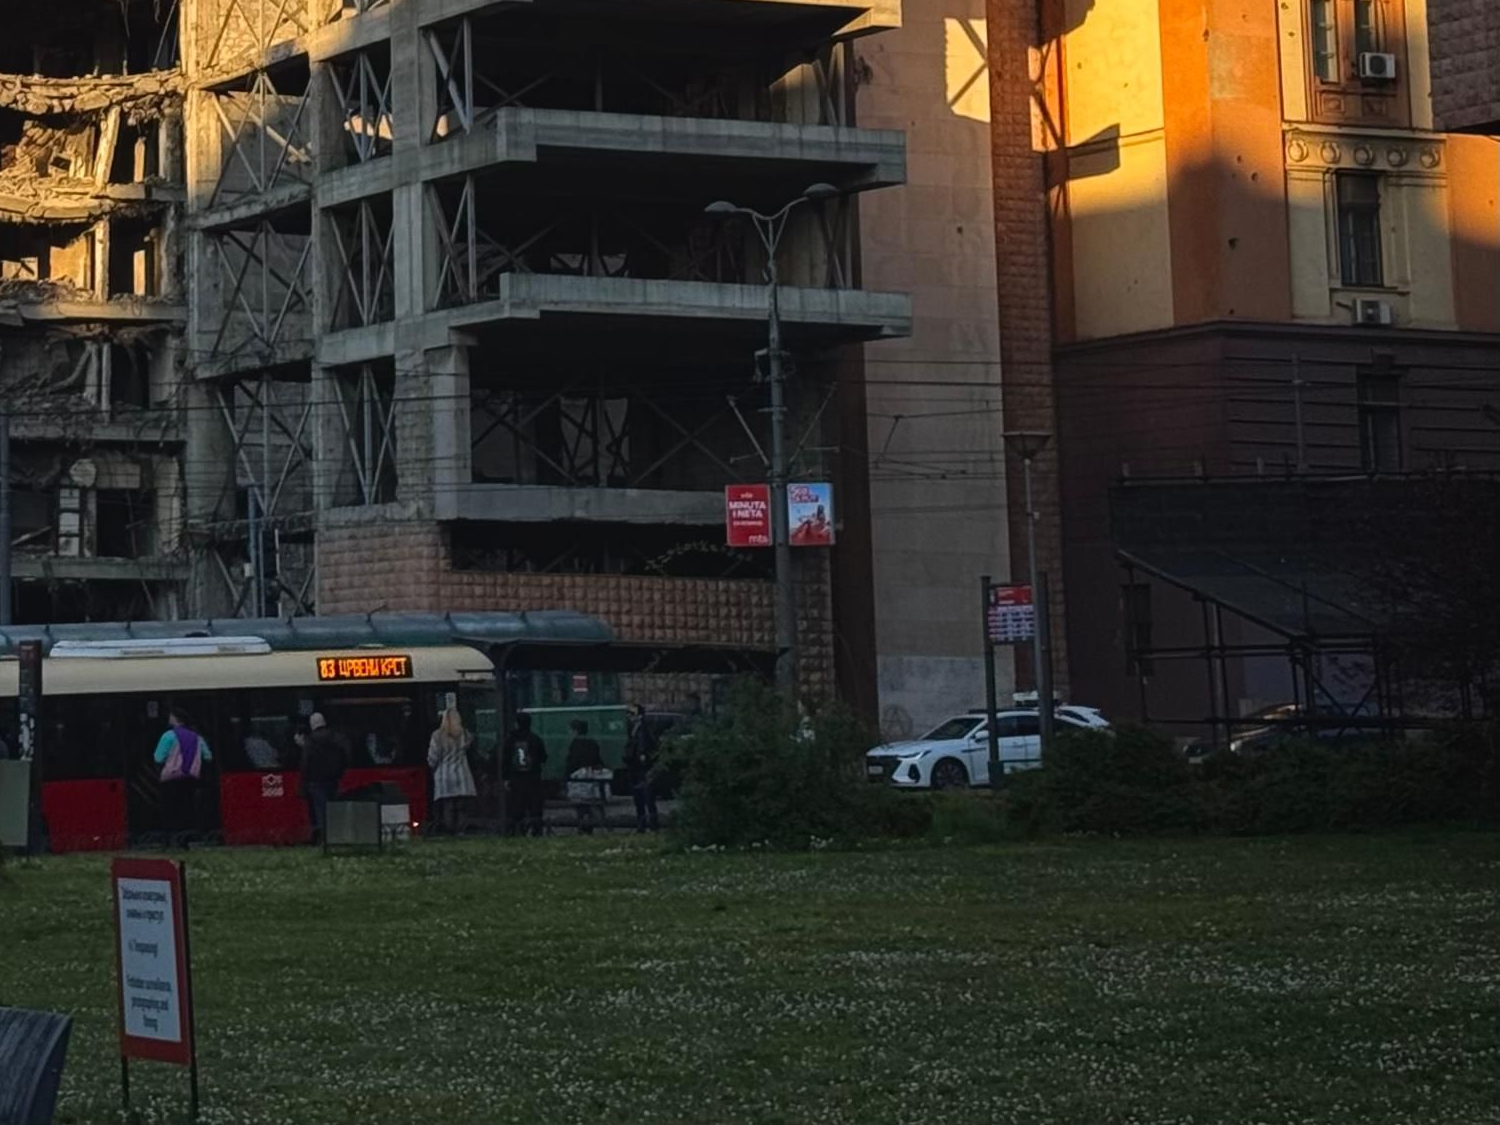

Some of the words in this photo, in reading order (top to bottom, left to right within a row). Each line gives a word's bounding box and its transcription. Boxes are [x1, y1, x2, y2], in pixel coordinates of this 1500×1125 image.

[729, 501, 767, 510] MINUTA
[738, 509, 764, 519] NETA
[320, 659, 336, 679] 83
[381, 656, 407, 677] КРСТ
